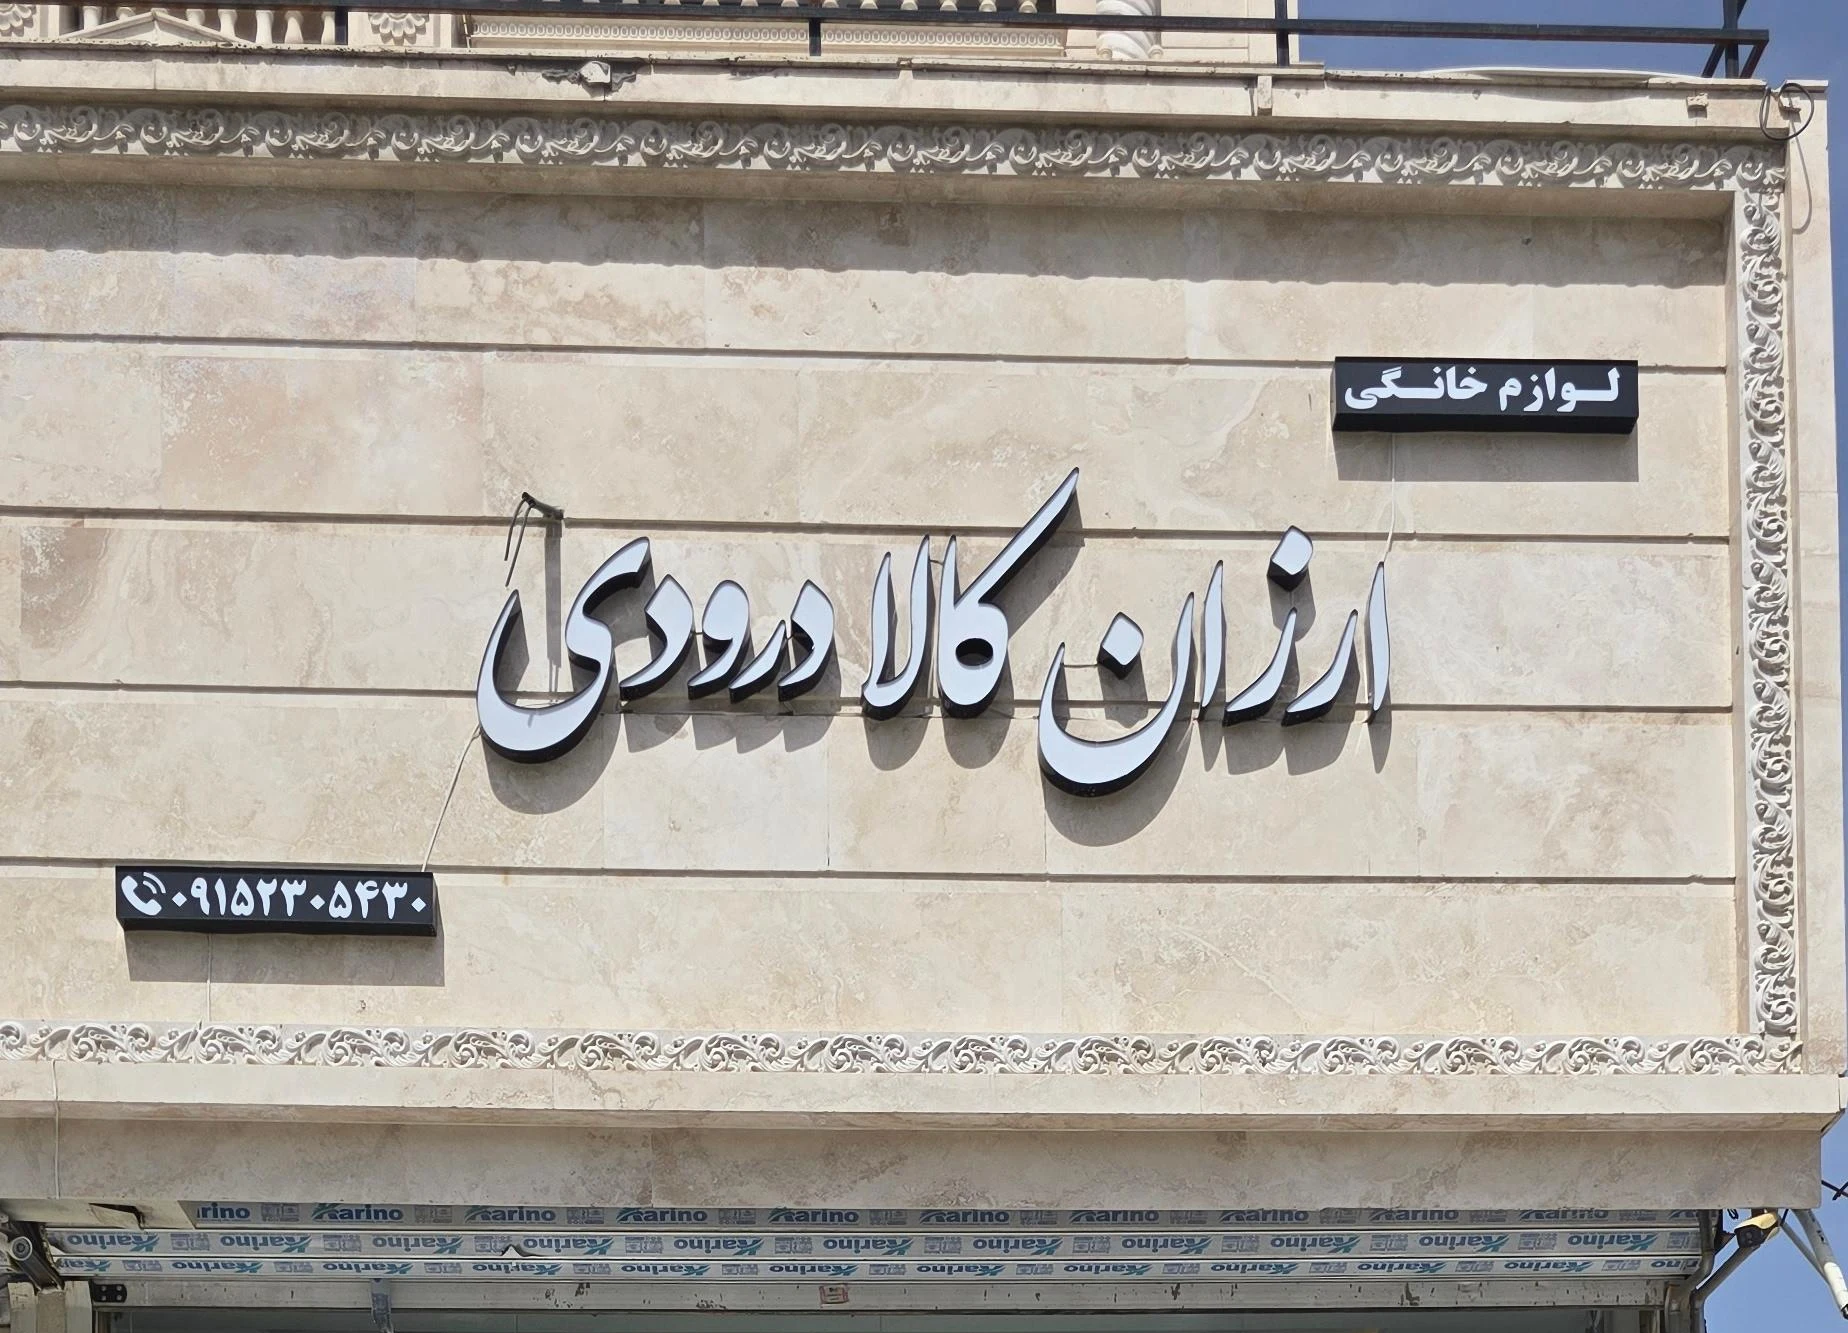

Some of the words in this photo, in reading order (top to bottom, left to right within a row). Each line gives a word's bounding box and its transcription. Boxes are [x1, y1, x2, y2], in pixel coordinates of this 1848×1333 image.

[1345, 366, 1488, 410] خانگی
[1499, 366, 1620, 412] لوازم
[862, 467, 1080, 721] کالا
[476, 536, 835, 765] درودی
[1038, 525, 1390, 798] ارزان
[171, 877, 427, 920] ۰۹۱۵۲۳۰۵۴۳۰
[197, 1202, 250, 1219] rino
